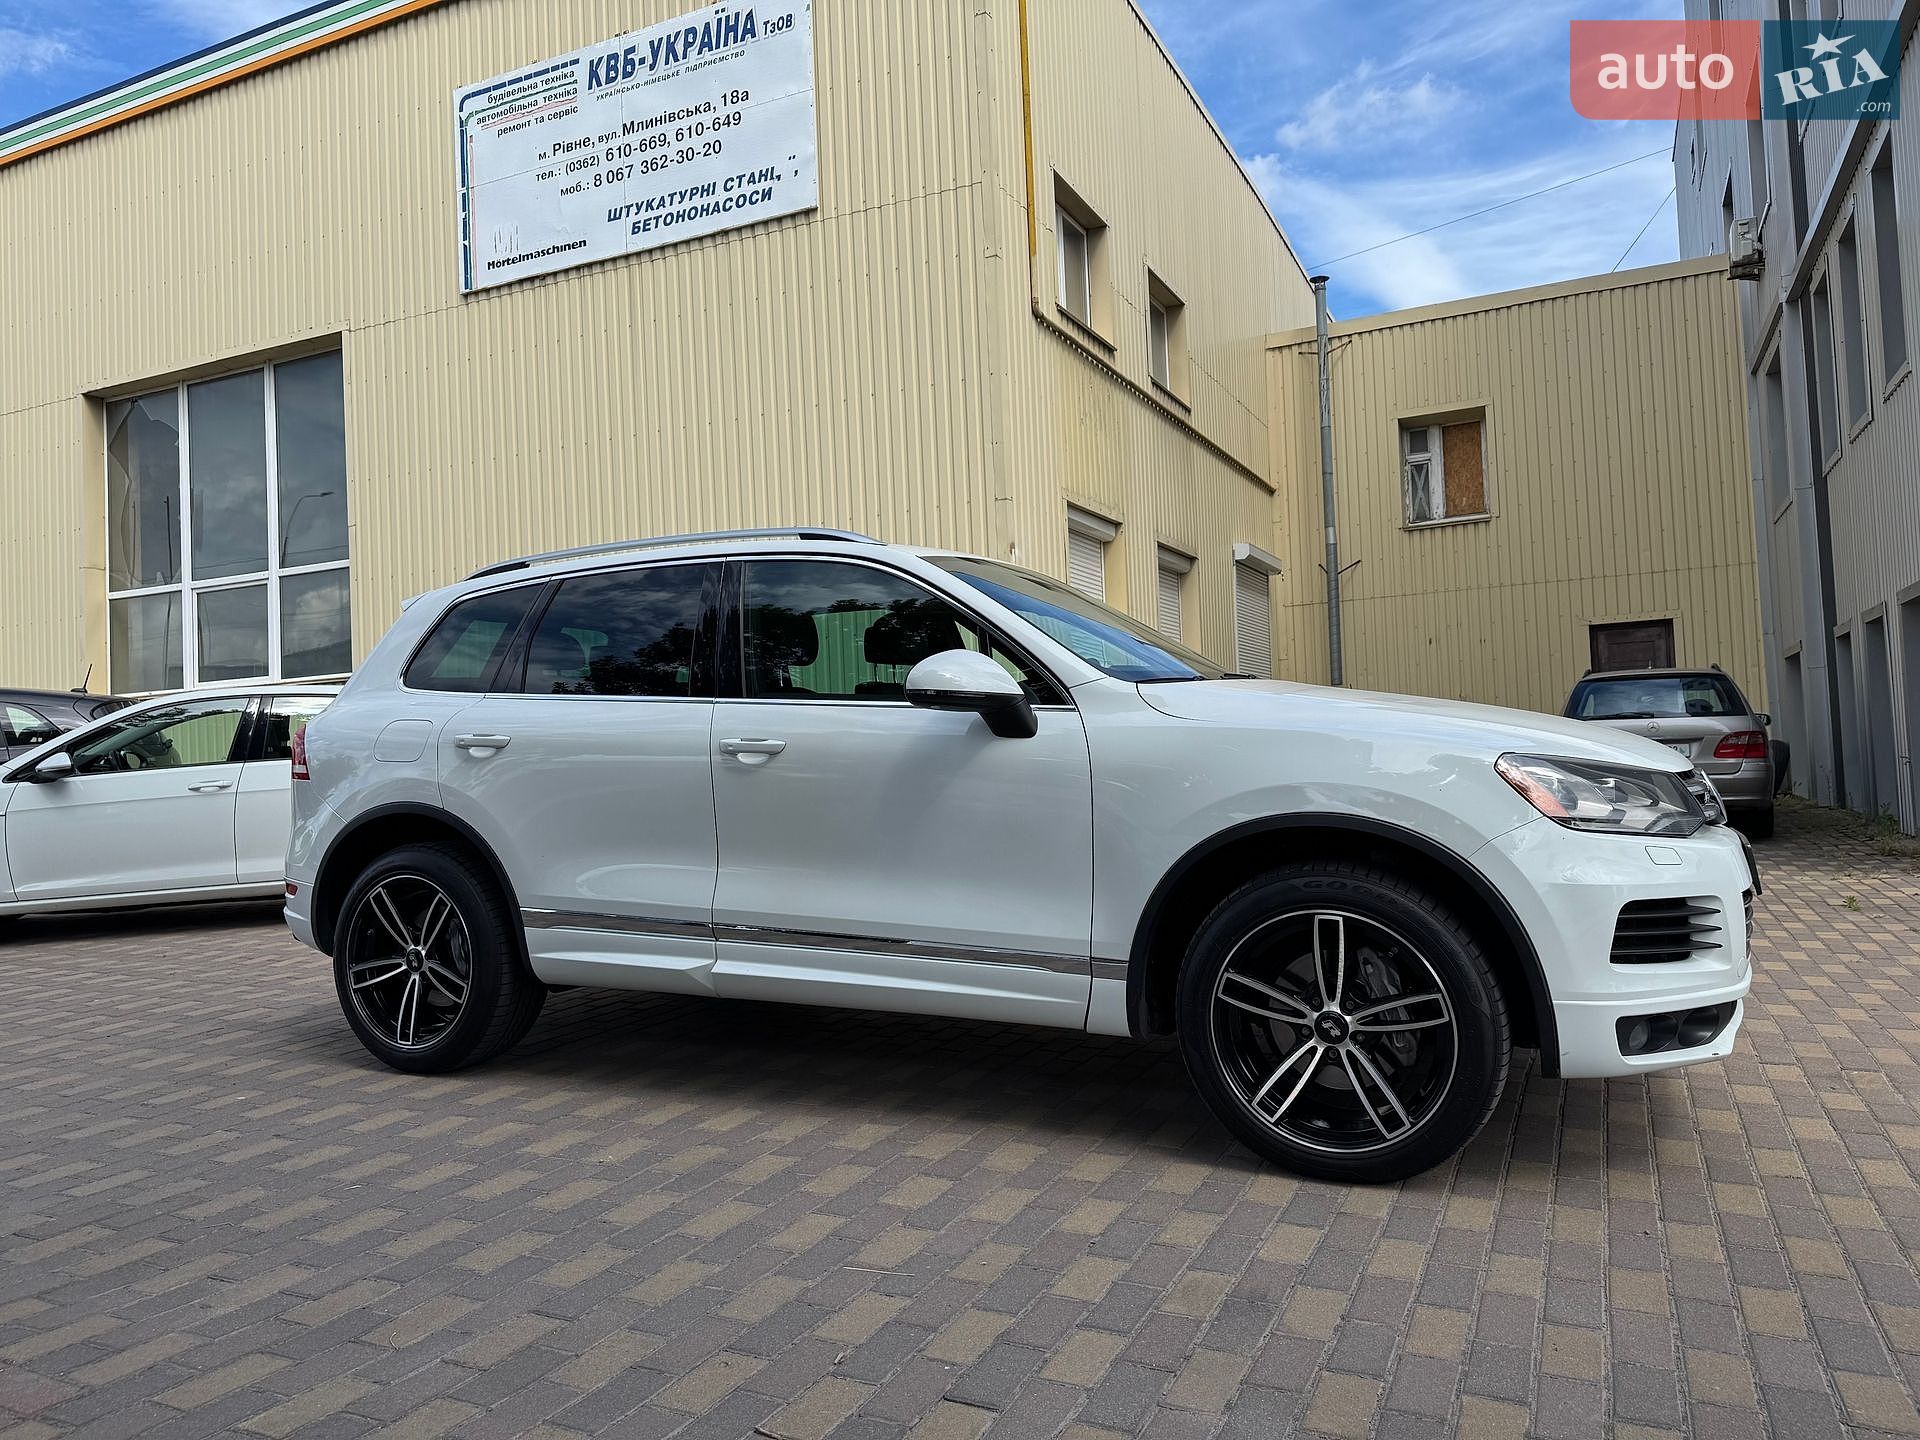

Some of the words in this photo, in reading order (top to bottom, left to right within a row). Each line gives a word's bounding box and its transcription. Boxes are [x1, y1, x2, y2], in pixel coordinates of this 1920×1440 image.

[587, 7, 758, 91] КВБ-УКРАЇНА
[476, 99, 538, 125] автомобільна
[542, 87, 578, 104] техніка
[487, 82, 538, 104] будівельна
[540, 70, 575, 87] техніка
[497, 120, 531, 138] ремонт
[534, 115, 545, 124] та
[547, 105, 579, 122] сервіс
[538, 151, 550, 161] м.
[552, 135, 595, 157] Рівне,
[598, 131, 621, 148] вул.
[622, 101, 717, 137] Млинівська,
[721, 89, 750, 107] 18а
[535, 167, 561, 182] тел.:
[565, 155, 600, 176] (0362)
[605, 133, 671, 162] 610-669,
[675, 111, 742, 142] 610-649
[560, 181, 590, 197] моб.:
[593, 174, 603, 188] 8
[606, 165, 634, 184] 067
[640, 140, 722, 175] 362-30-20
[607, 182, 717, 222] ШТУКАТУРНІ
[631, 187, 773, 236] БЕТОНОНАСОСИ
